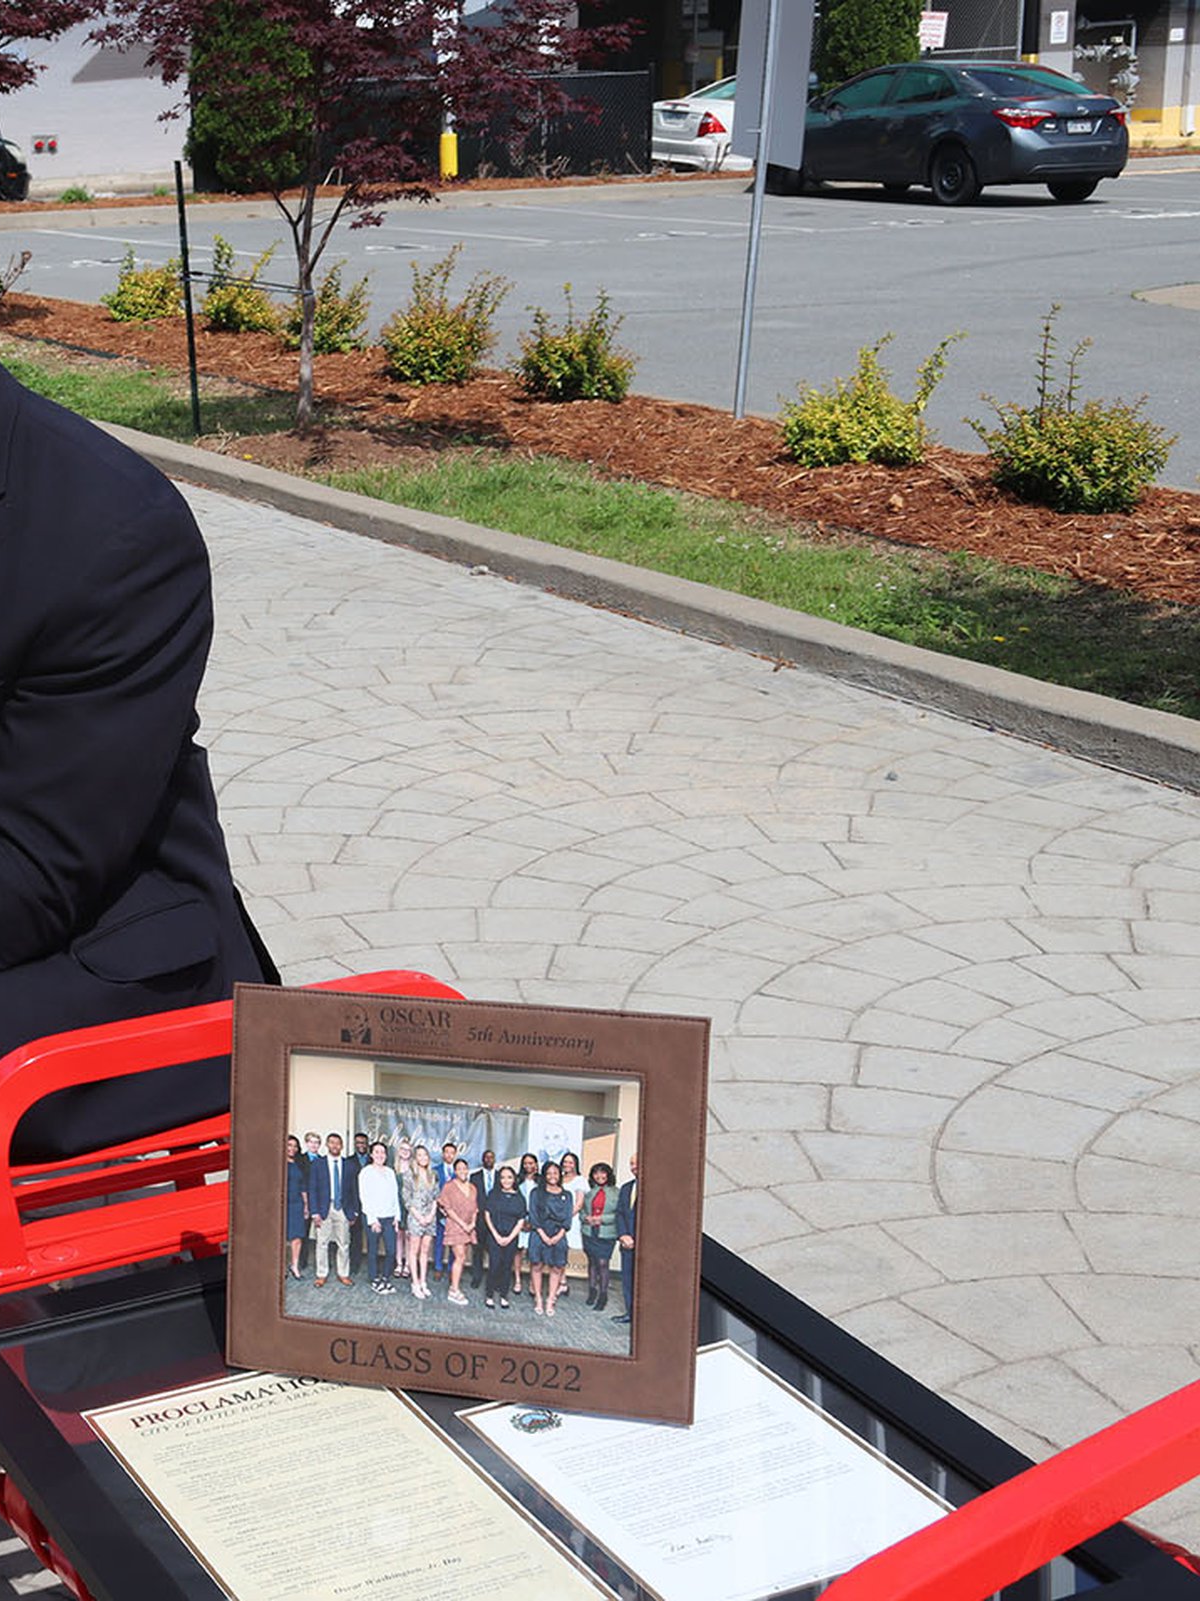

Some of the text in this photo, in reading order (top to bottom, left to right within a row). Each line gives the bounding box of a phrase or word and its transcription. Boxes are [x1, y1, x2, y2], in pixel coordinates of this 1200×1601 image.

[379, 1006, 451, 1029] OSCAR
[466, 1026, 493, 1044] 5th
[499, 1029, 596, 1056] Anniversary
[329, 1337, 583, 1393] CLASS OF 2022
[130, 1375, 328, 1429] PROCLAMATIO
